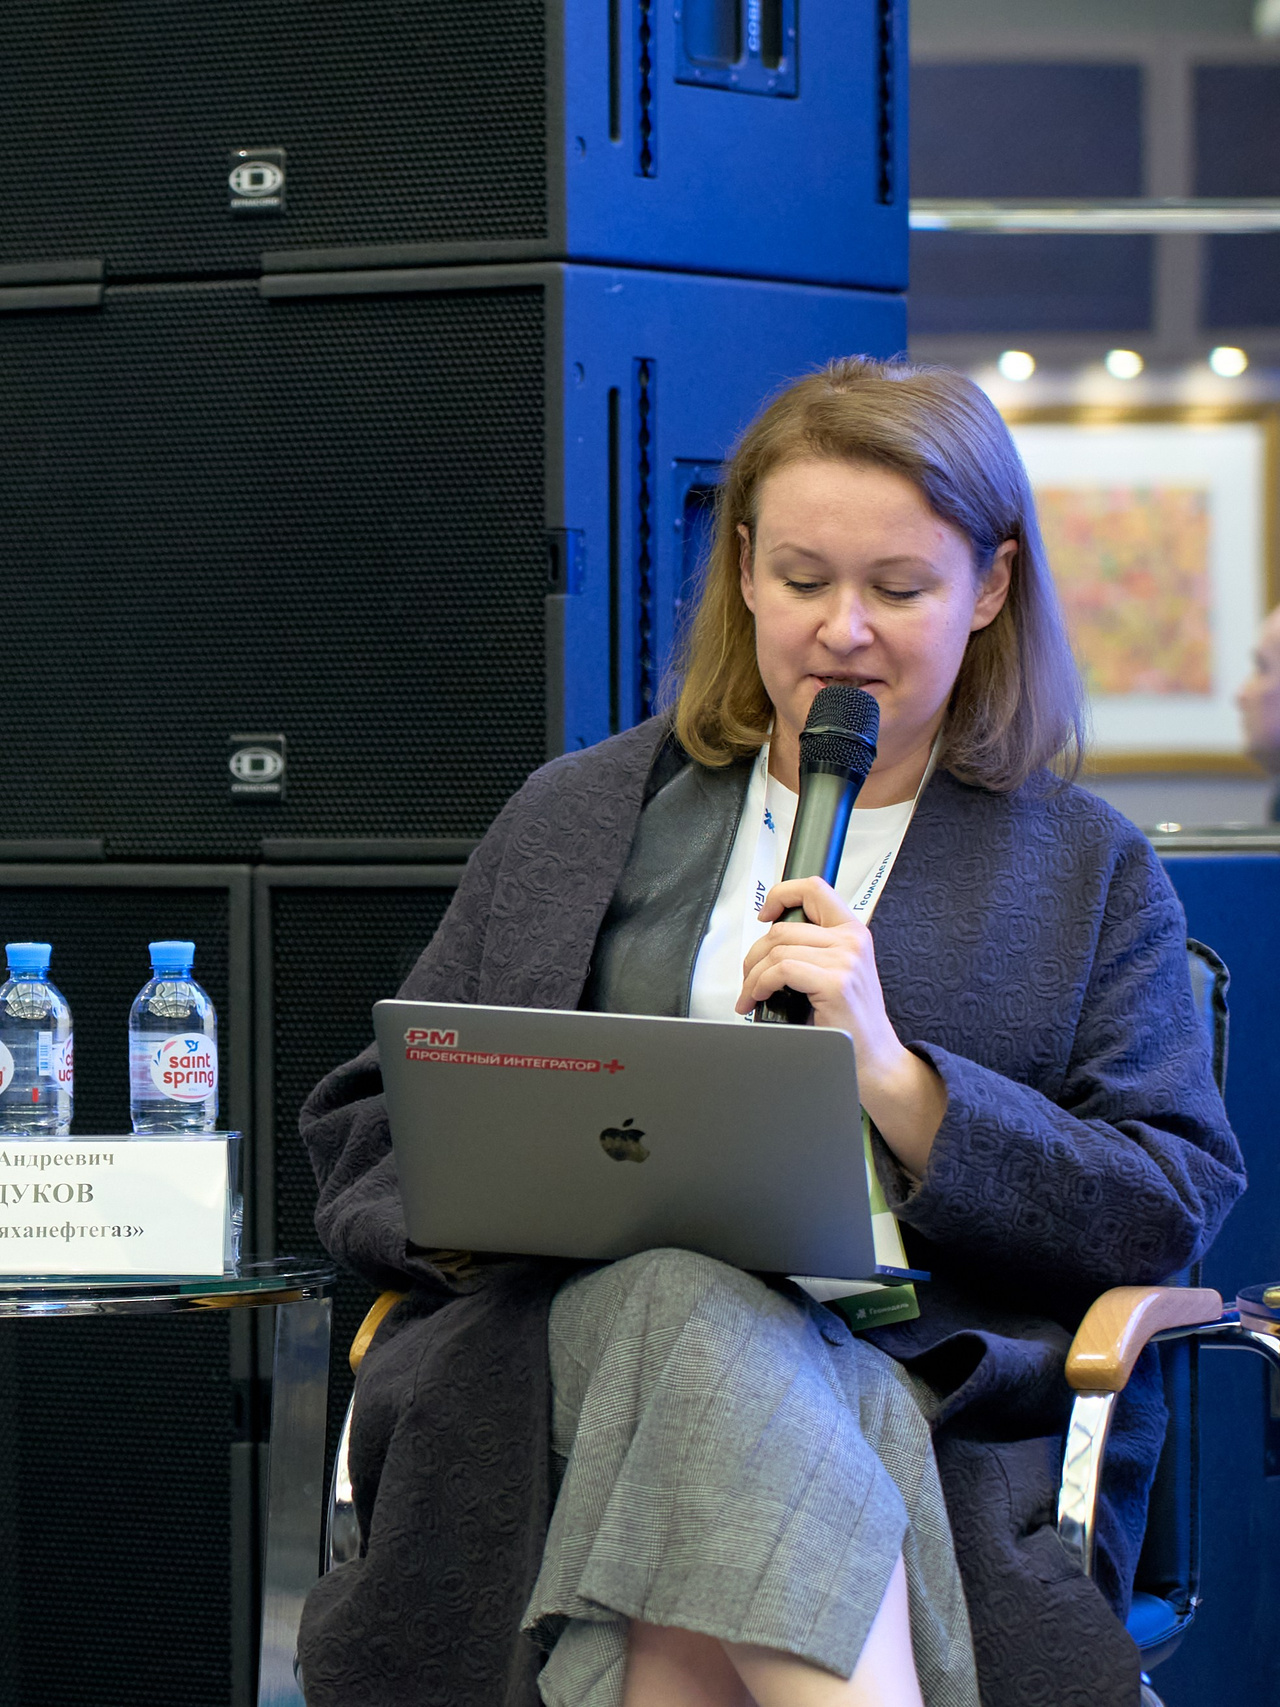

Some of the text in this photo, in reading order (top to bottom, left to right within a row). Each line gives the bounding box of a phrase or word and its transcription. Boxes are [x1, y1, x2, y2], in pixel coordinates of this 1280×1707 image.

[853, 851, 892, 911] Геомодель
[169, 1053, 210, 1068] saint
[410, 1049, 596, 1071] ПРОЕКТНЫЙ ИНТЕГРАТОР
[163, 1071, 214, 1088] spring
